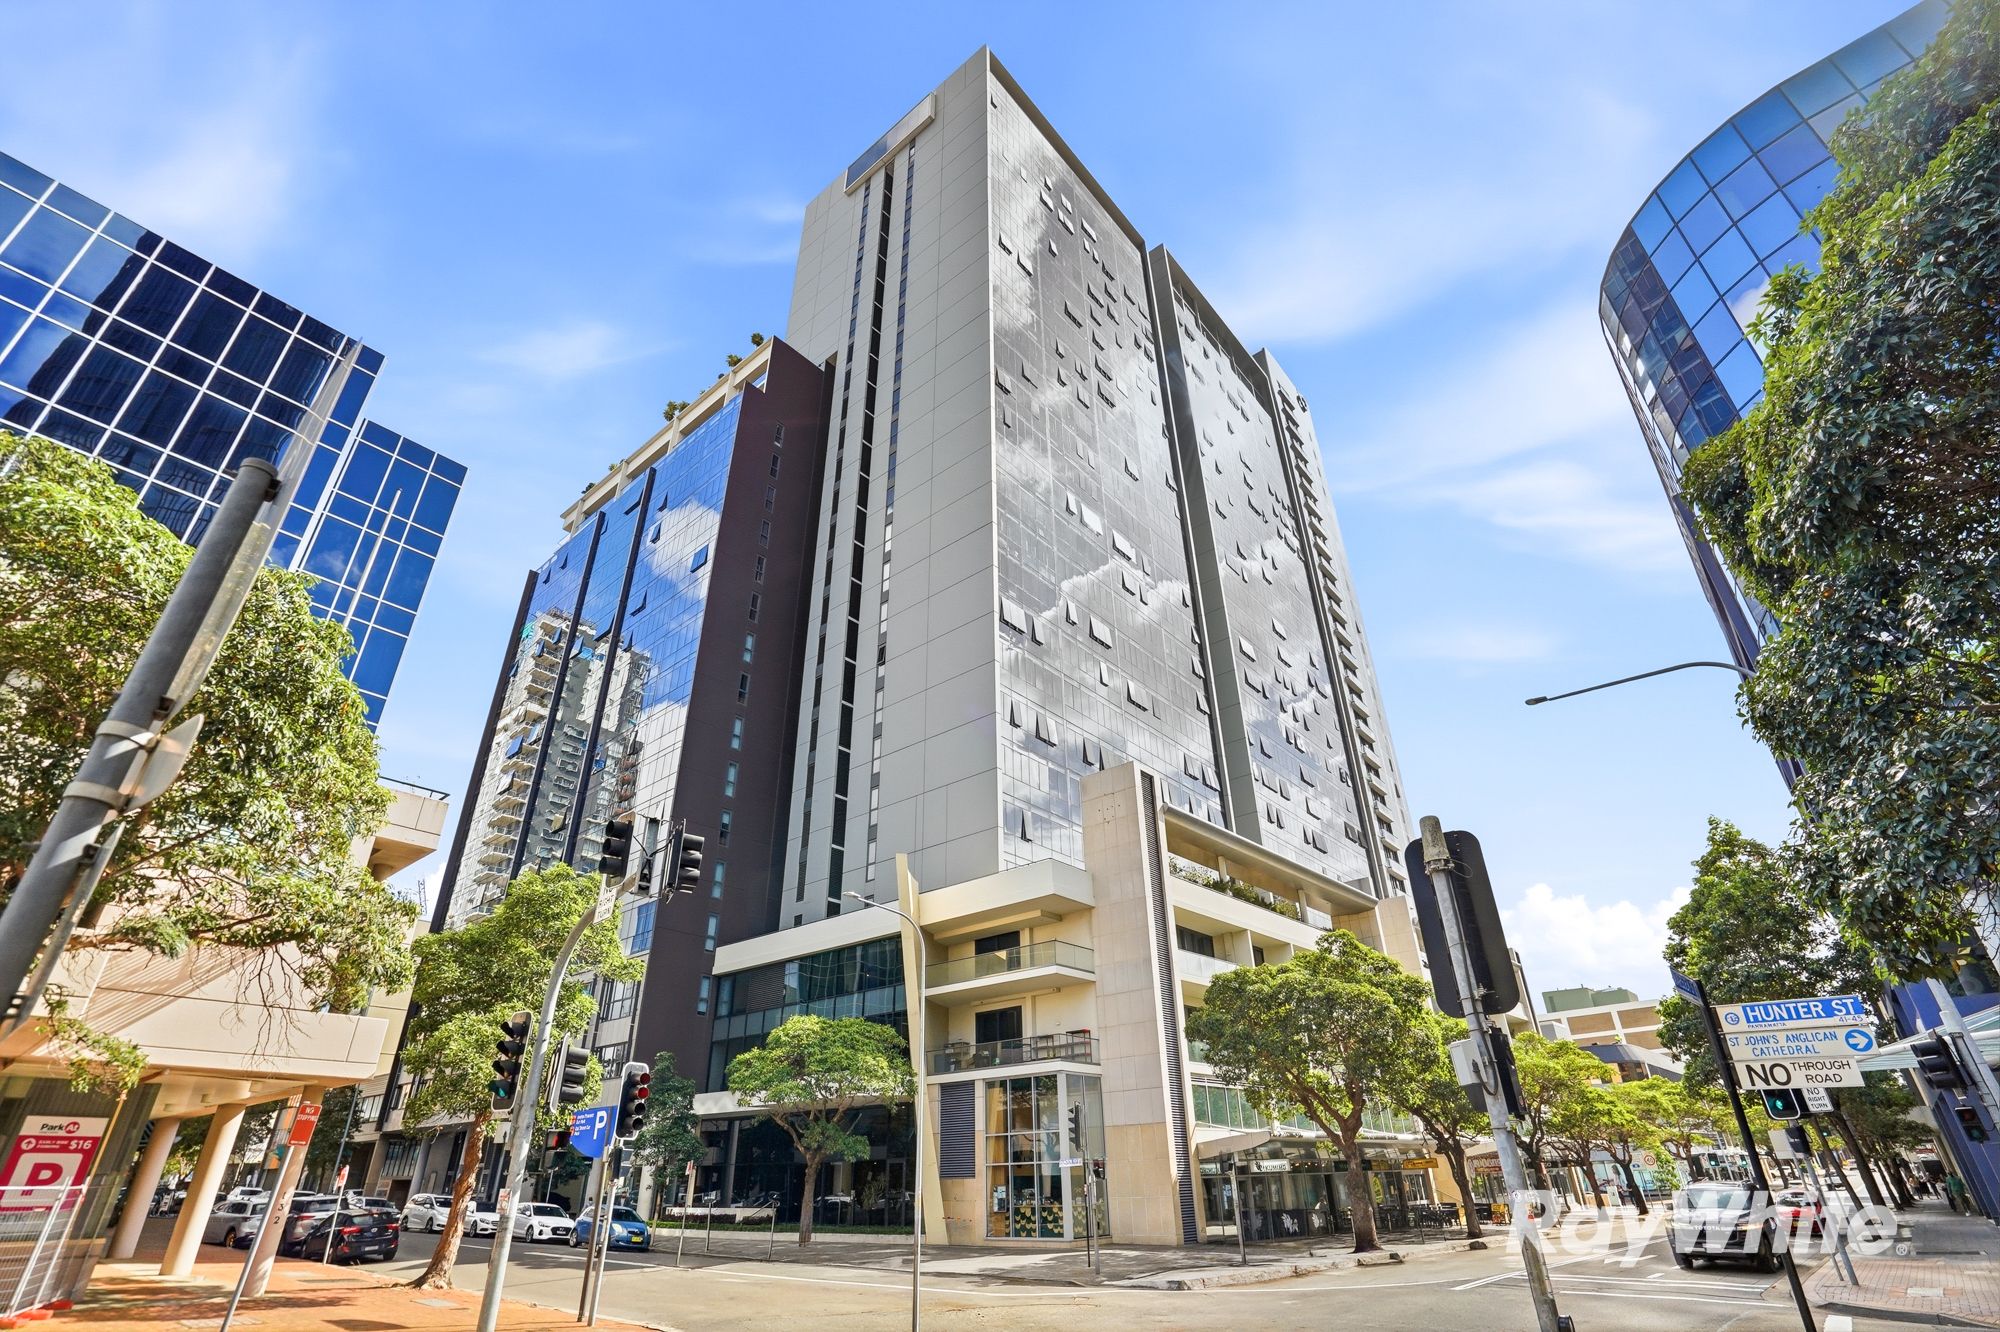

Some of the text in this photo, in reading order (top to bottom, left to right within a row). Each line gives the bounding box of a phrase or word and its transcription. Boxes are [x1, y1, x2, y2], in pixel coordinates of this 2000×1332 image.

[1746, 999, 1856, 1023] HUNTER ST
[1838, 1015, 1864, 1023] 41-45
[1728, 1031, 1838, 1047] ST JOHN'S ANGLICAN
[1752, 1044, 1820, 1057] CATHEDRAL
[1745, 1060, 1851, 1087] NO THROUGH
[1805, 1073, 1843, 1084] ROAD
[1806, 1087, 1820, 1095] NO
[593, 1110, 607, 1140] P
[69, 1139, 93, 1150] $16
[21, 1162, 63, 1196] P
